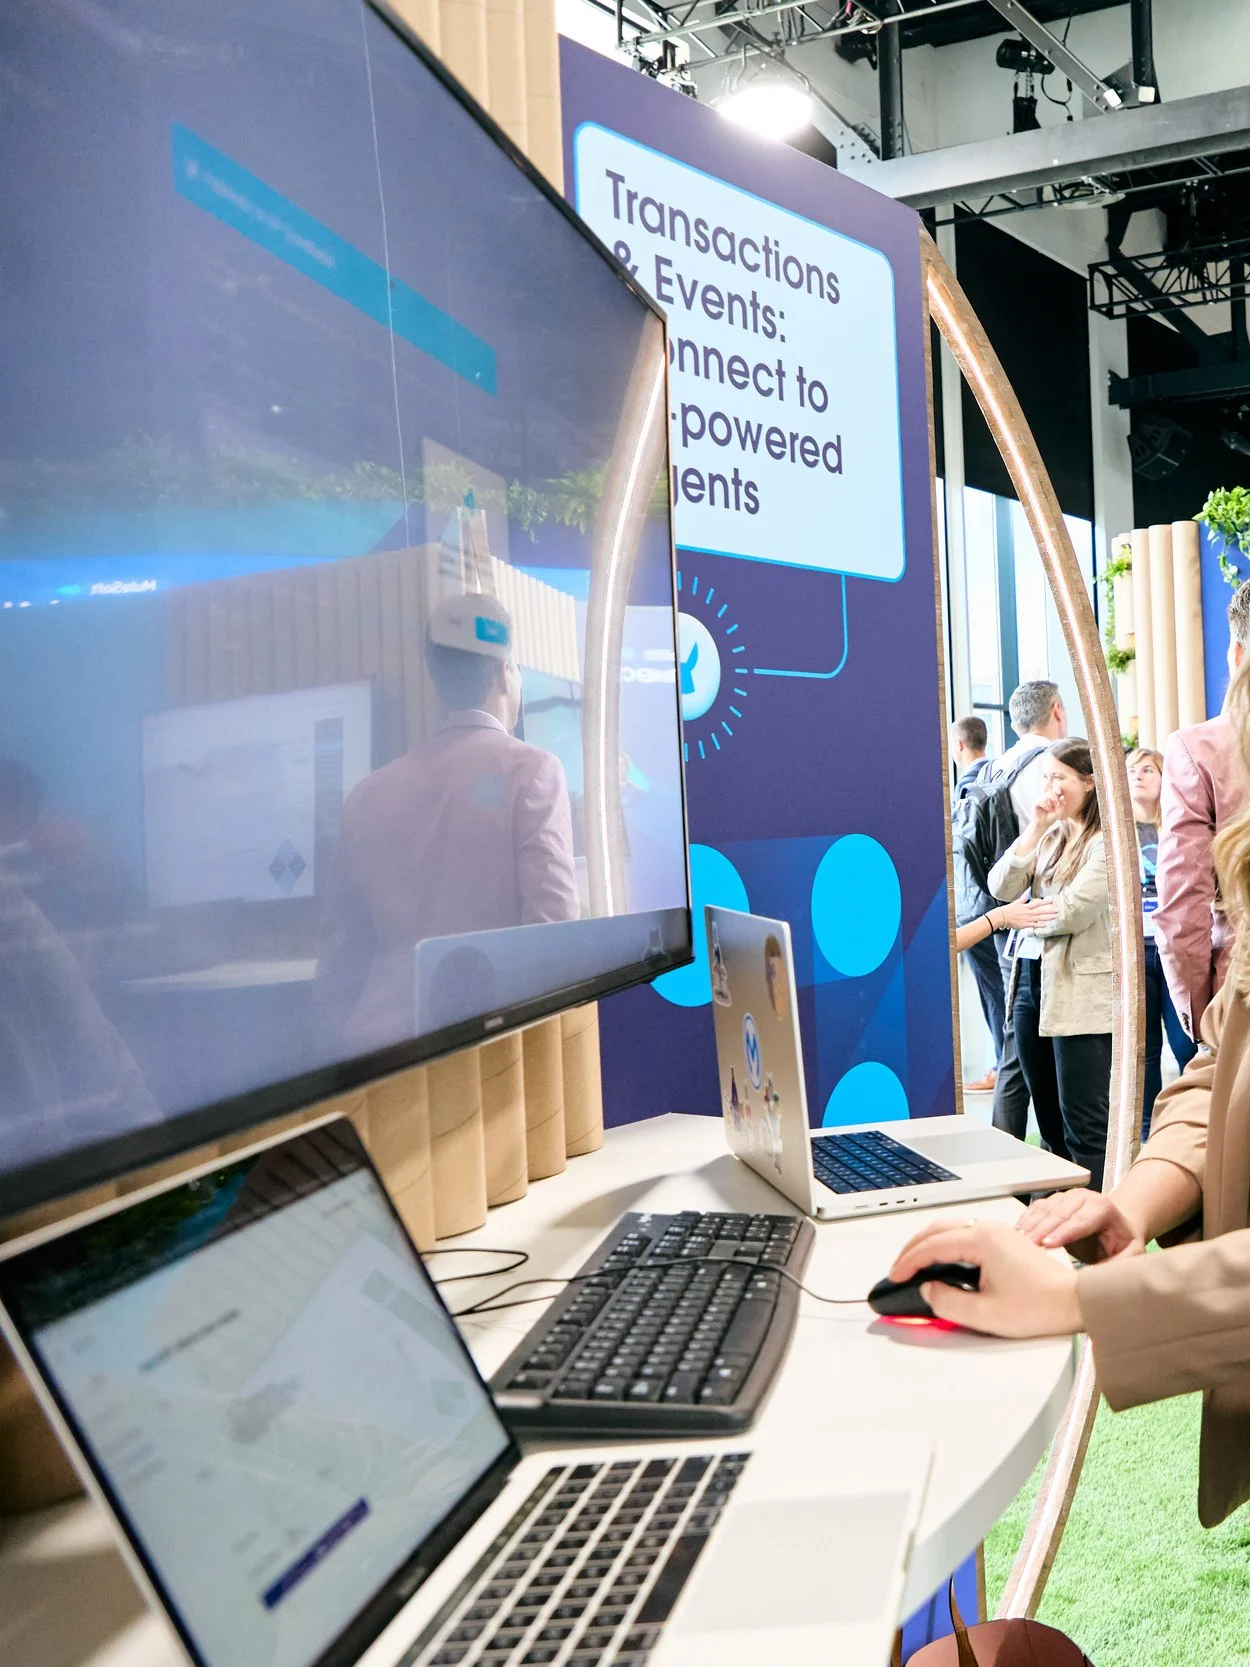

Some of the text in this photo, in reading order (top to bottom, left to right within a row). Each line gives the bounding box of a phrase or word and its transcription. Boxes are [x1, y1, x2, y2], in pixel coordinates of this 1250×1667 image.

[605, 168, 840, 306] Transactions
[655, 253, 787, 344] Events:
[669, 337, 830, 414] nnect to
[673, 464, 761, 515] ents
